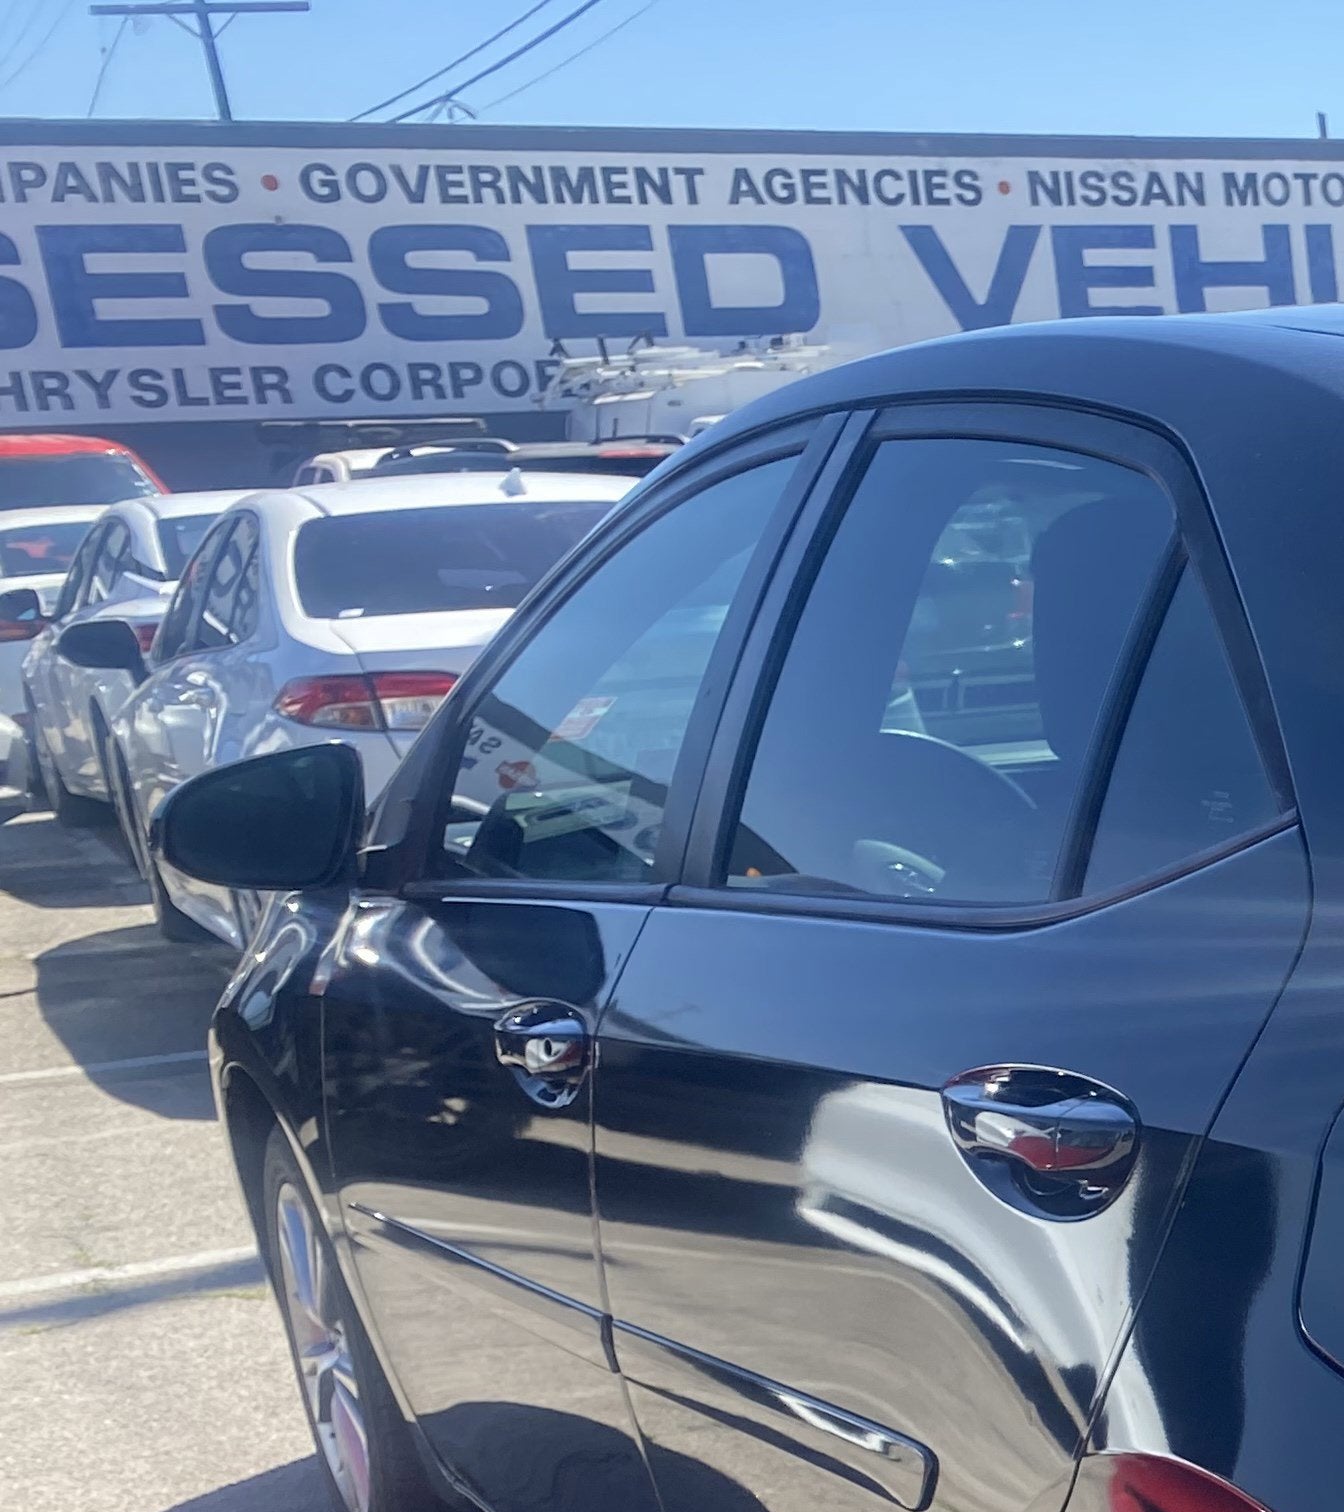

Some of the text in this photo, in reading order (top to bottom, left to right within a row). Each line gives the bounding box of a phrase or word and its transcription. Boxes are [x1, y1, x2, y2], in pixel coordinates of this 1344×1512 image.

[0, 160, 240, 204] PANIES
[300, 161, 705, 206] GOVERNMENT
[729, 167, 983, 207] AGENCIES
[1028, 169, 1206, 208] NISSAN
[0, 223, 820, 350] ESSED
